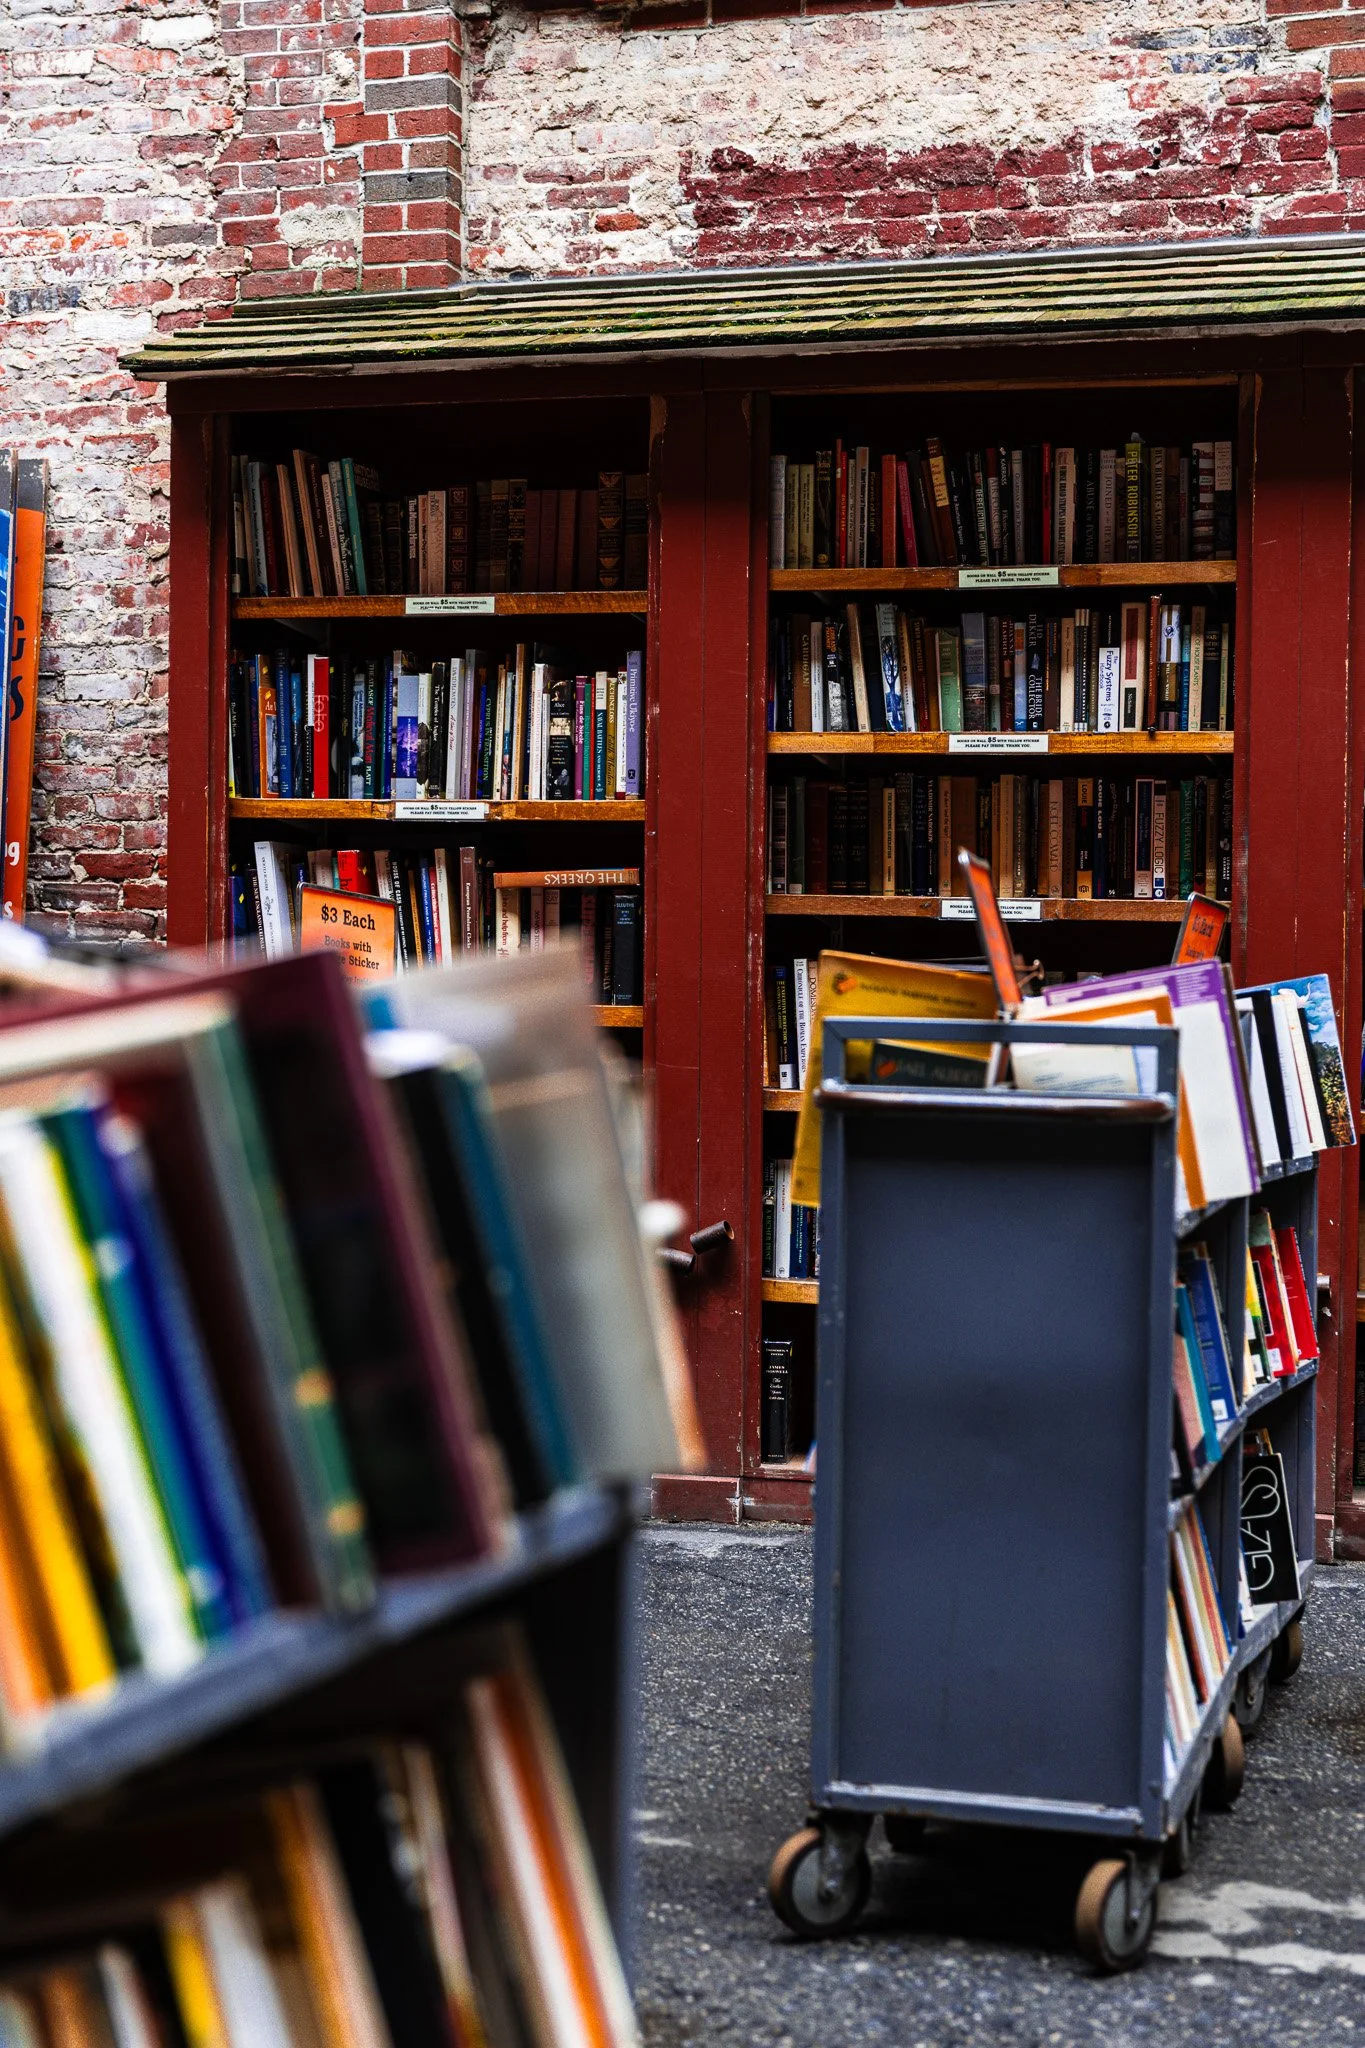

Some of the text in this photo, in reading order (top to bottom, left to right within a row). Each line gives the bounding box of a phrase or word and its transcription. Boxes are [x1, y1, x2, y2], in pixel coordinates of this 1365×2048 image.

[1128, 451, 1138, 537] PETER ROBINSON
[333, 498, 342, 524] century
[976, 489, 984, 531] DERELICTION
[1085, 481, 1094, 558] ABUSE POWER
[339, 535, 347, 559] British
[342, 561, 350, 591] painting
[1105, 651, 1113, 701] Fuzzy Systems
[314, 695, 329, 732] foto
[368, 697, 374, 705] OF
[629, 669, 637, 732] Primitive Ukiyo-e
[365, 706, 375, 740] Medieval
[365, 744, 375, 763] Man
[607, 755, 615, 786] Wharton
[1155, 813, 1164, 873] FUZZY LOGIC
[544, 872, 625, 885] THE GREEKS
[321, 903, 375, 930] $3 Each
[325, 935, 371, 952] Books with
[349, 955, 379, 970] Sticker
